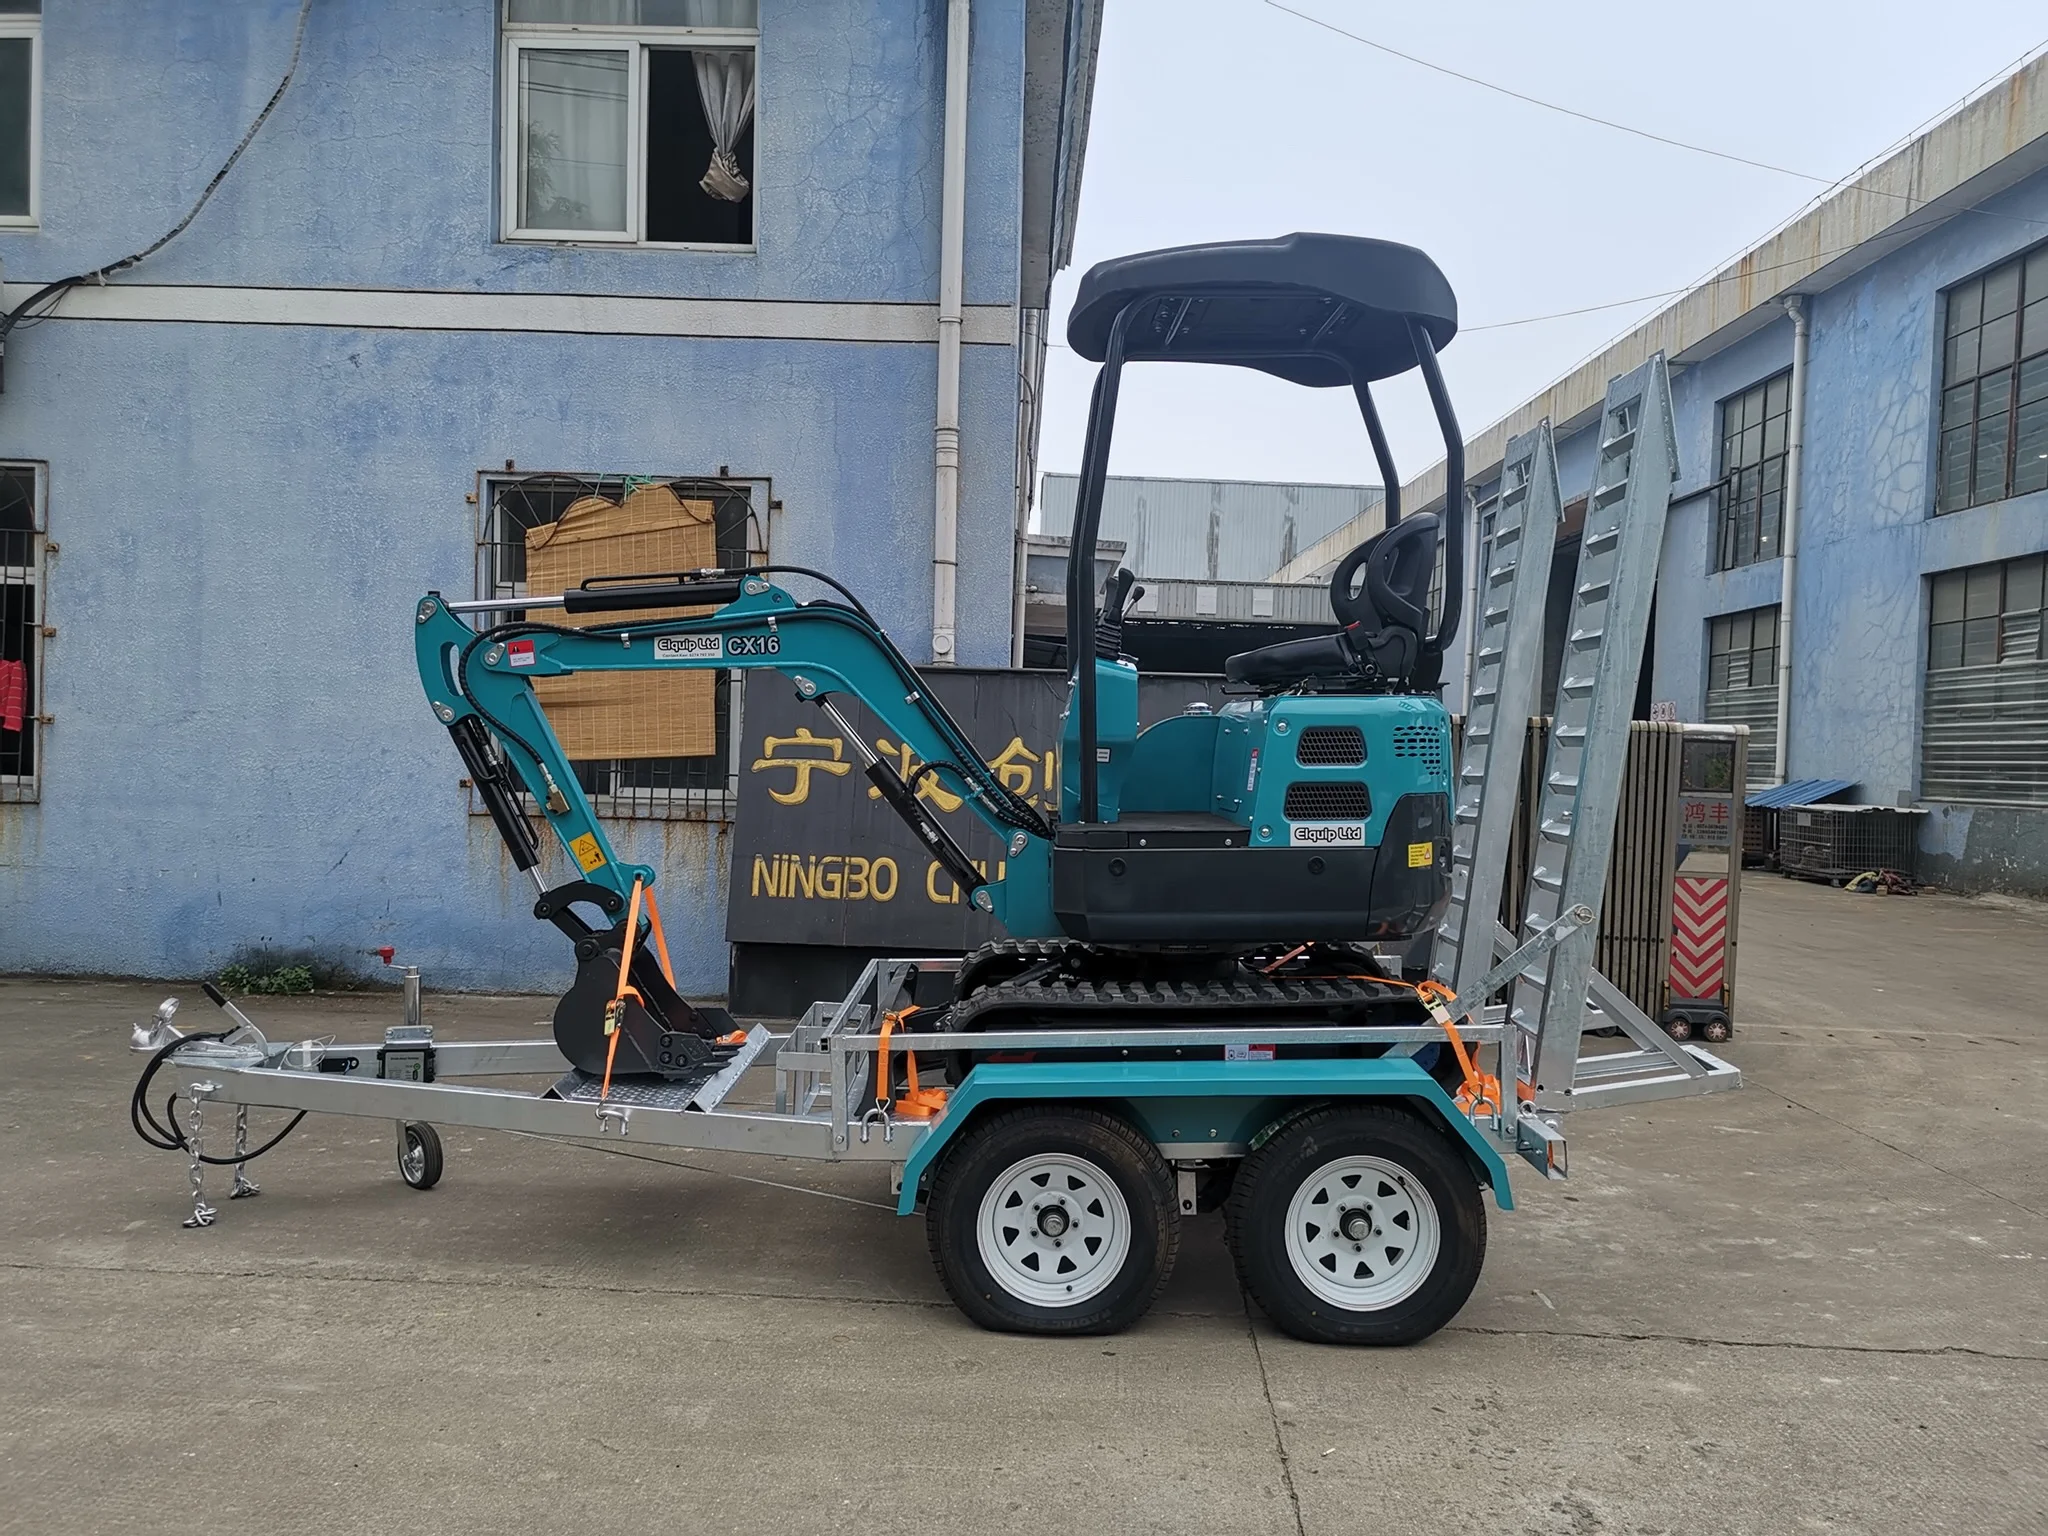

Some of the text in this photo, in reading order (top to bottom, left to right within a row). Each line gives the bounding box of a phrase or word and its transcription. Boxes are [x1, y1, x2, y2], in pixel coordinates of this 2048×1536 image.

[698, 637, 720, 650] Ltd
[726, 635, 780, 655] CX16
[1684, 801, 1729, 824] 鸿丰
[1338, 827, 1362, 840] Ltd
[751, 853, 899, 902] NINGBO
